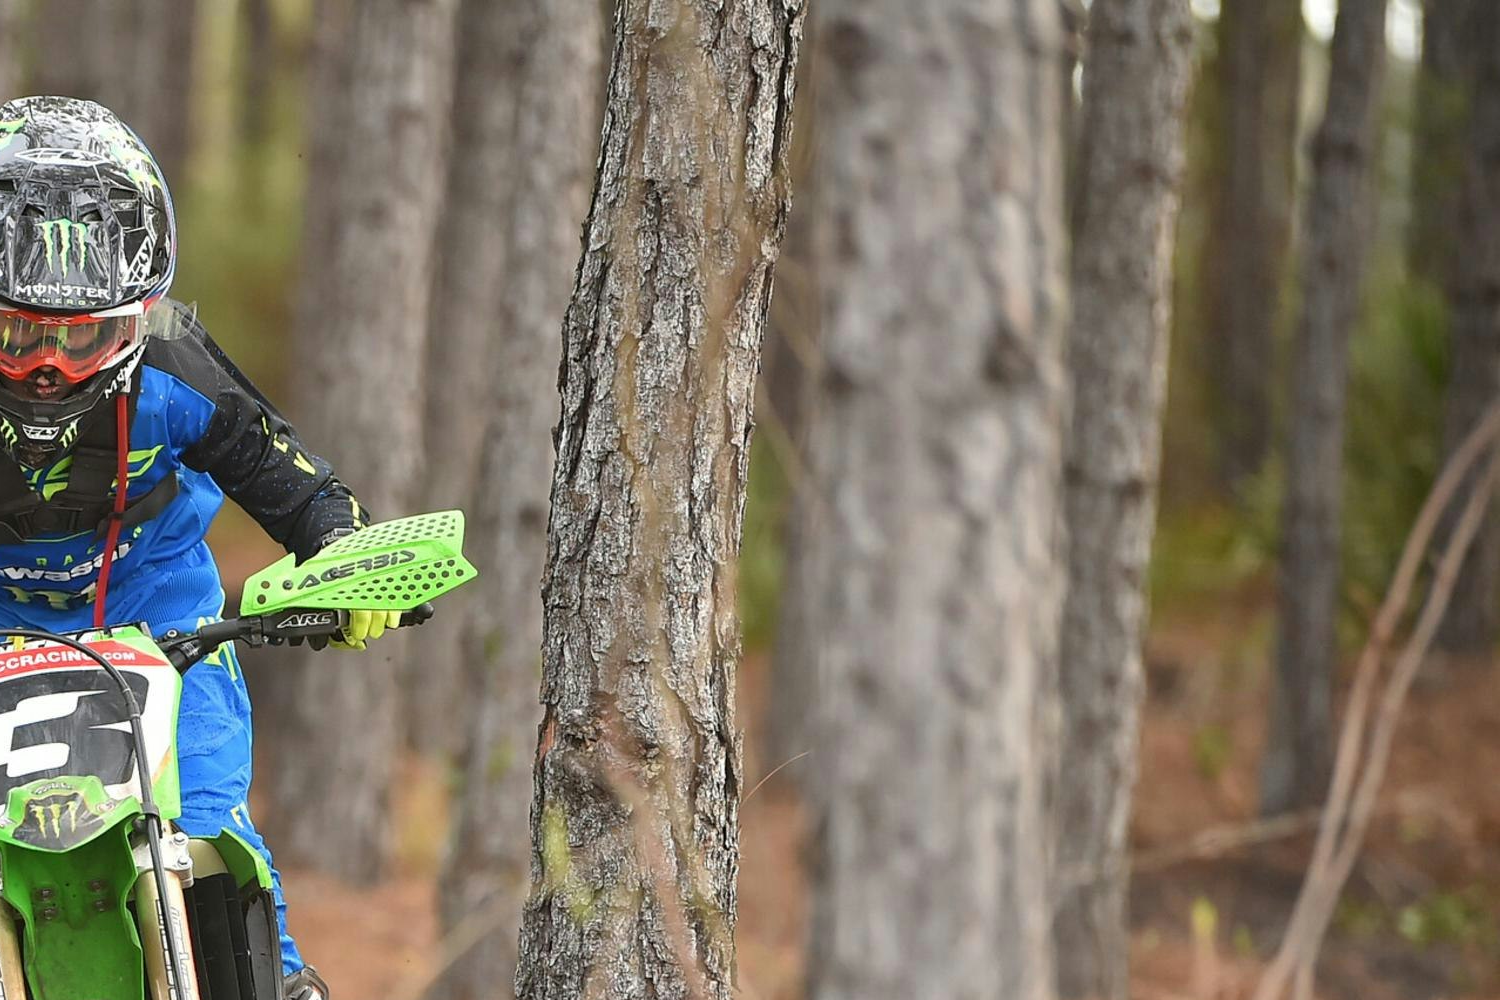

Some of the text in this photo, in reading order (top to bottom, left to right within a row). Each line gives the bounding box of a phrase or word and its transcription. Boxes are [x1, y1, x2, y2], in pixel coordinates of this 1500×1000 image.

[15, 282, 111, 300] MONSTER
[30, 298, 97, 306] ENERGY
[297, 550, 416, 590] ACERBIS
[277, 612, 334, 629] ARC
